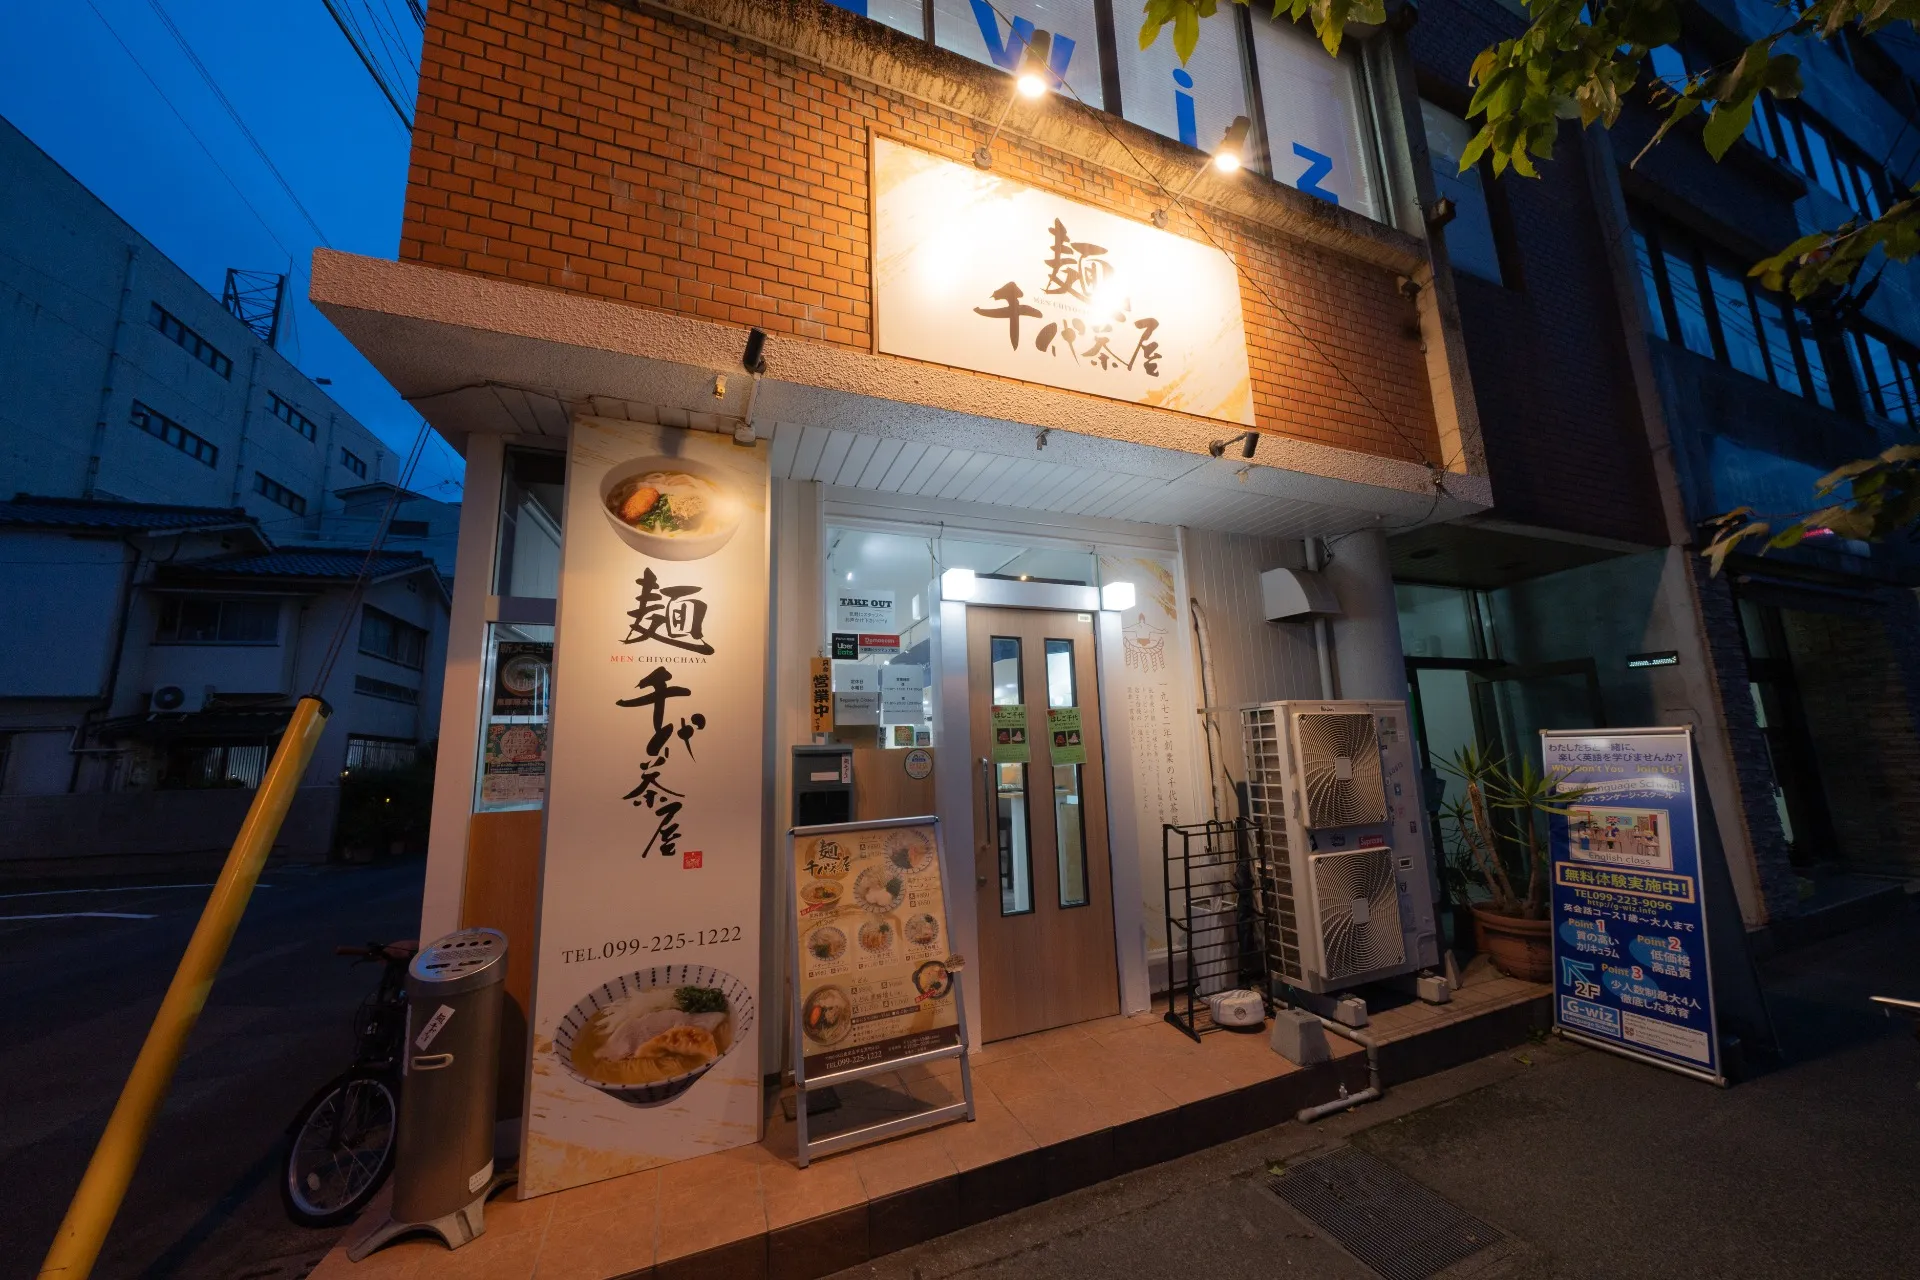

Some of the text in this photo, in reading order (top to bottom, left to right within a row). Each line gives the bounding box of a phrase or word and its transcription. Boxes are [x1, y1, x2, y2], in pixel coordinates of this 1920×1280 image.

[1041, 217, 1131, 320] 麺
[972, 281, 1163, 378] 千代茶屋
[619, 566, 716, 656] 麺
[840, 598, 893, 608] TAKE OUT
[837, 642, 853, 650] Uber
[610, 655, 708, 665] MEN CHIYOCHAYA
[1548, 742, 1635, 752] わたしたちと緒に、
[615, 665, 707, 859] 千代茶屋
[1552, 764, 1572, 773] Why
[1603, 764, 1625, 773] You
[1588, 852, 1651, 865] English class
[1574, 889, 1673, 911] TEL099-223-9096
[1587, 899, 1657, 915] http://g-wiz.info
[1568, 918, 1606, 933] Point 1
[1576, 930, 1620, 946] 質の高い
[1637, 934, 1682, 952] Point 2
[1576, 943, 1620, 959] カリキュラム
[1650, 949, 1691, 967] 低価格
[1601, 963, 1643, 980] Point 3
[1651, 963, 1692, 980] 高品質
[1575, 981, 1600, 999] 2F
[1611, 979, 1702, 1011] 少人数制最大4人
[1566, 1001, 1614, 1023] G-wiz
[1620, 995, 1691, 1019] 徹底した教育
[1565, 1014, 1618, 1033] Language School
